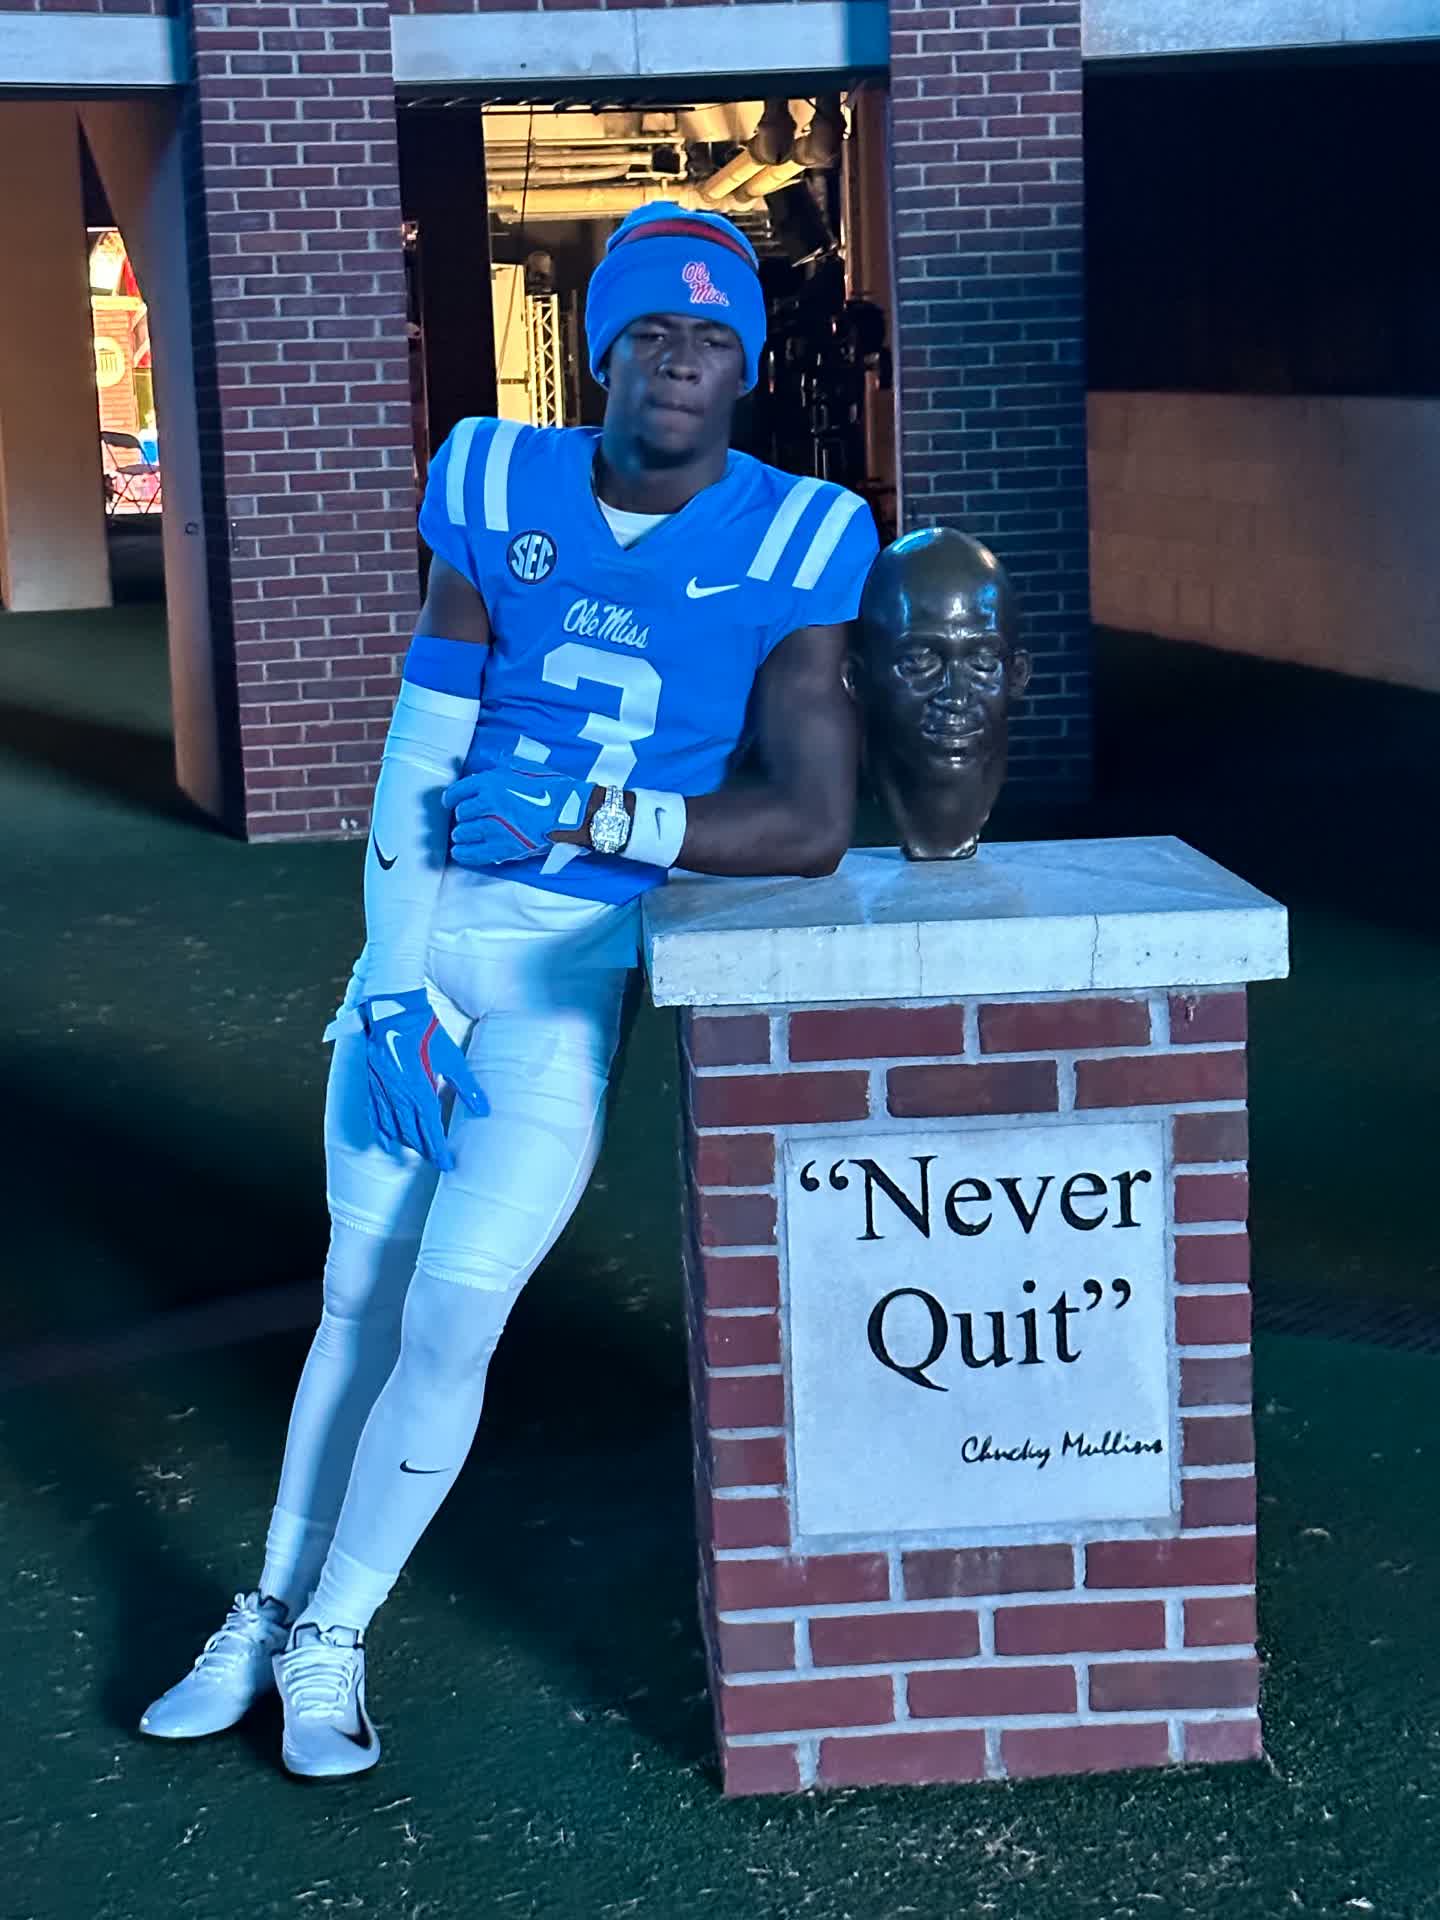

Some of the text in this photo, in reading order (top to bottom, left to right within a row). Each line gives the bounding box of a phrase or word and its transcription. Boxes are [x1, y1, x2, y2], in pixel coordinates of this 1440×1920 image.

[682, 261, 710, 283] Ole
[690, 281, 730, 307] Miss
[511, 533, 554, 580] SEC
[563, 598, 650, 649] Ole Miss
[800, 1155, 1152, 1240] “Never
[867, 1278, 1131, 1392] Quit”
[1061, 1429, 1163, 1457] Mullins
